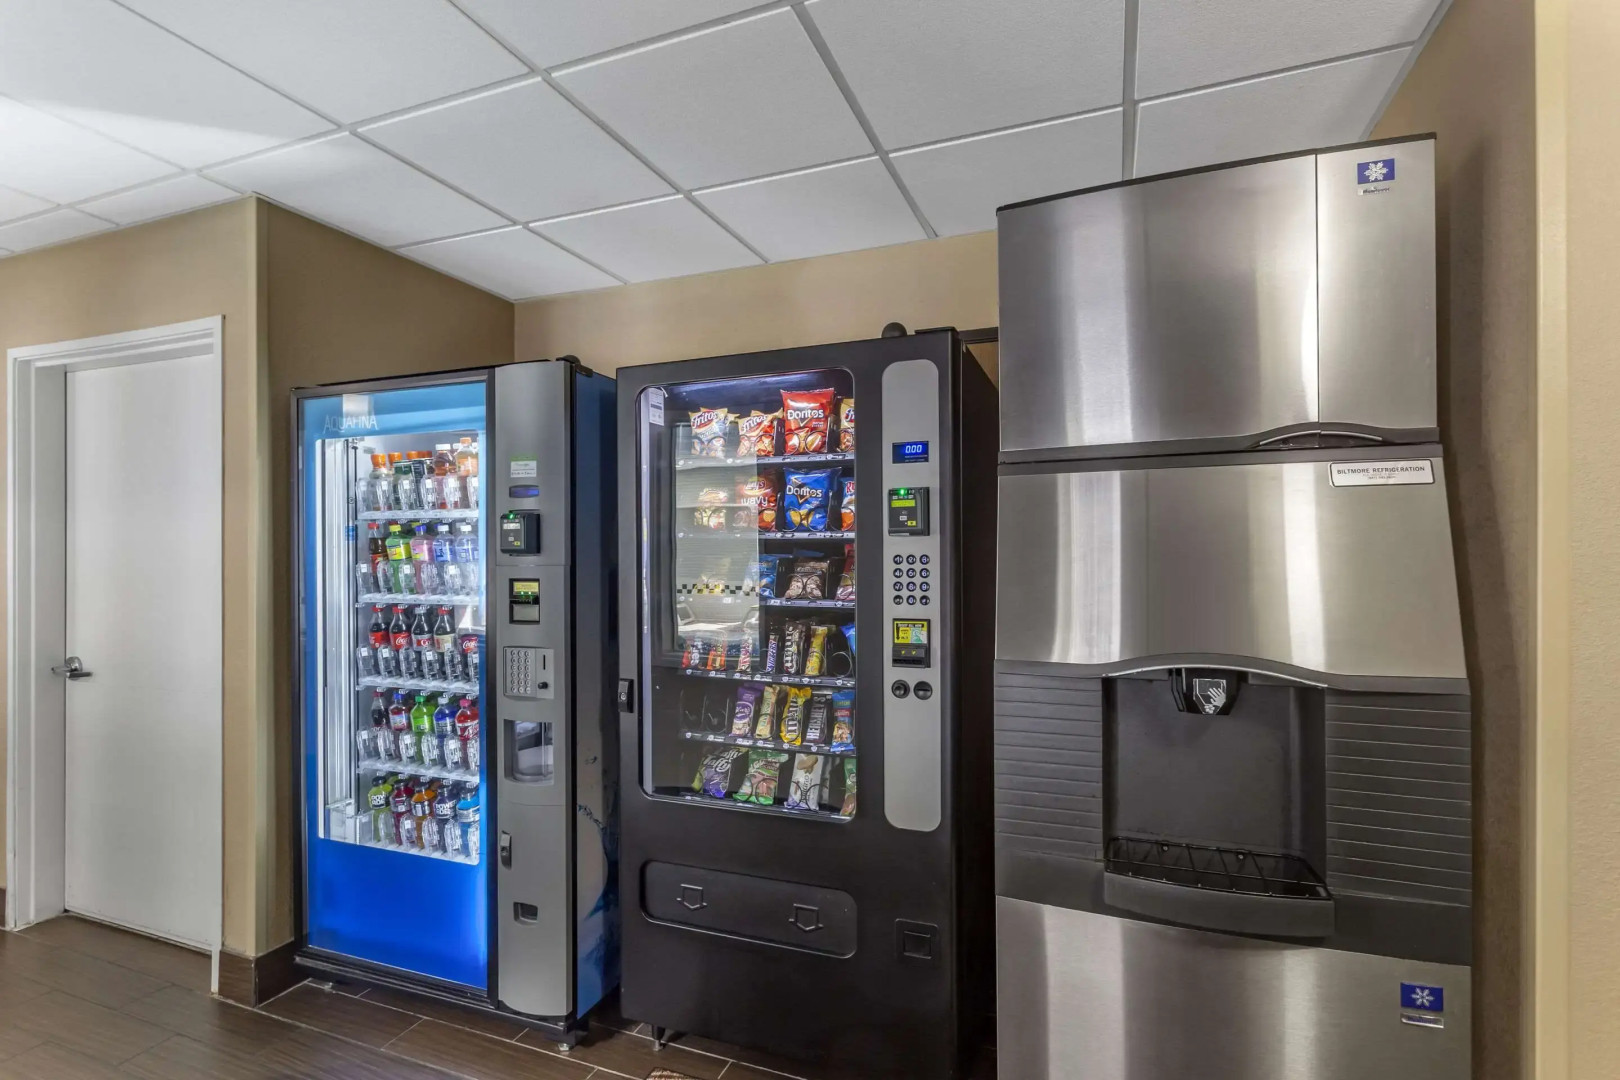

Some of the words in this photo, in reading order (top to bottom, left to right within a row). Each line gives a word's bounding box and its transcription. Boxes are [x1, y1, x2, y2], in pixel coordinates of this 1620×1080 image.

[691, 411, 718, 429] Fritos
[787, 409, 824, 420] Doritos
[741, 415, 768, 433] Fritos
[1372, 466, 1426, 474] REFRIGERATION
[786, 485, 823, 498] Doritos
[703, 755, 731, 773] Taffy
